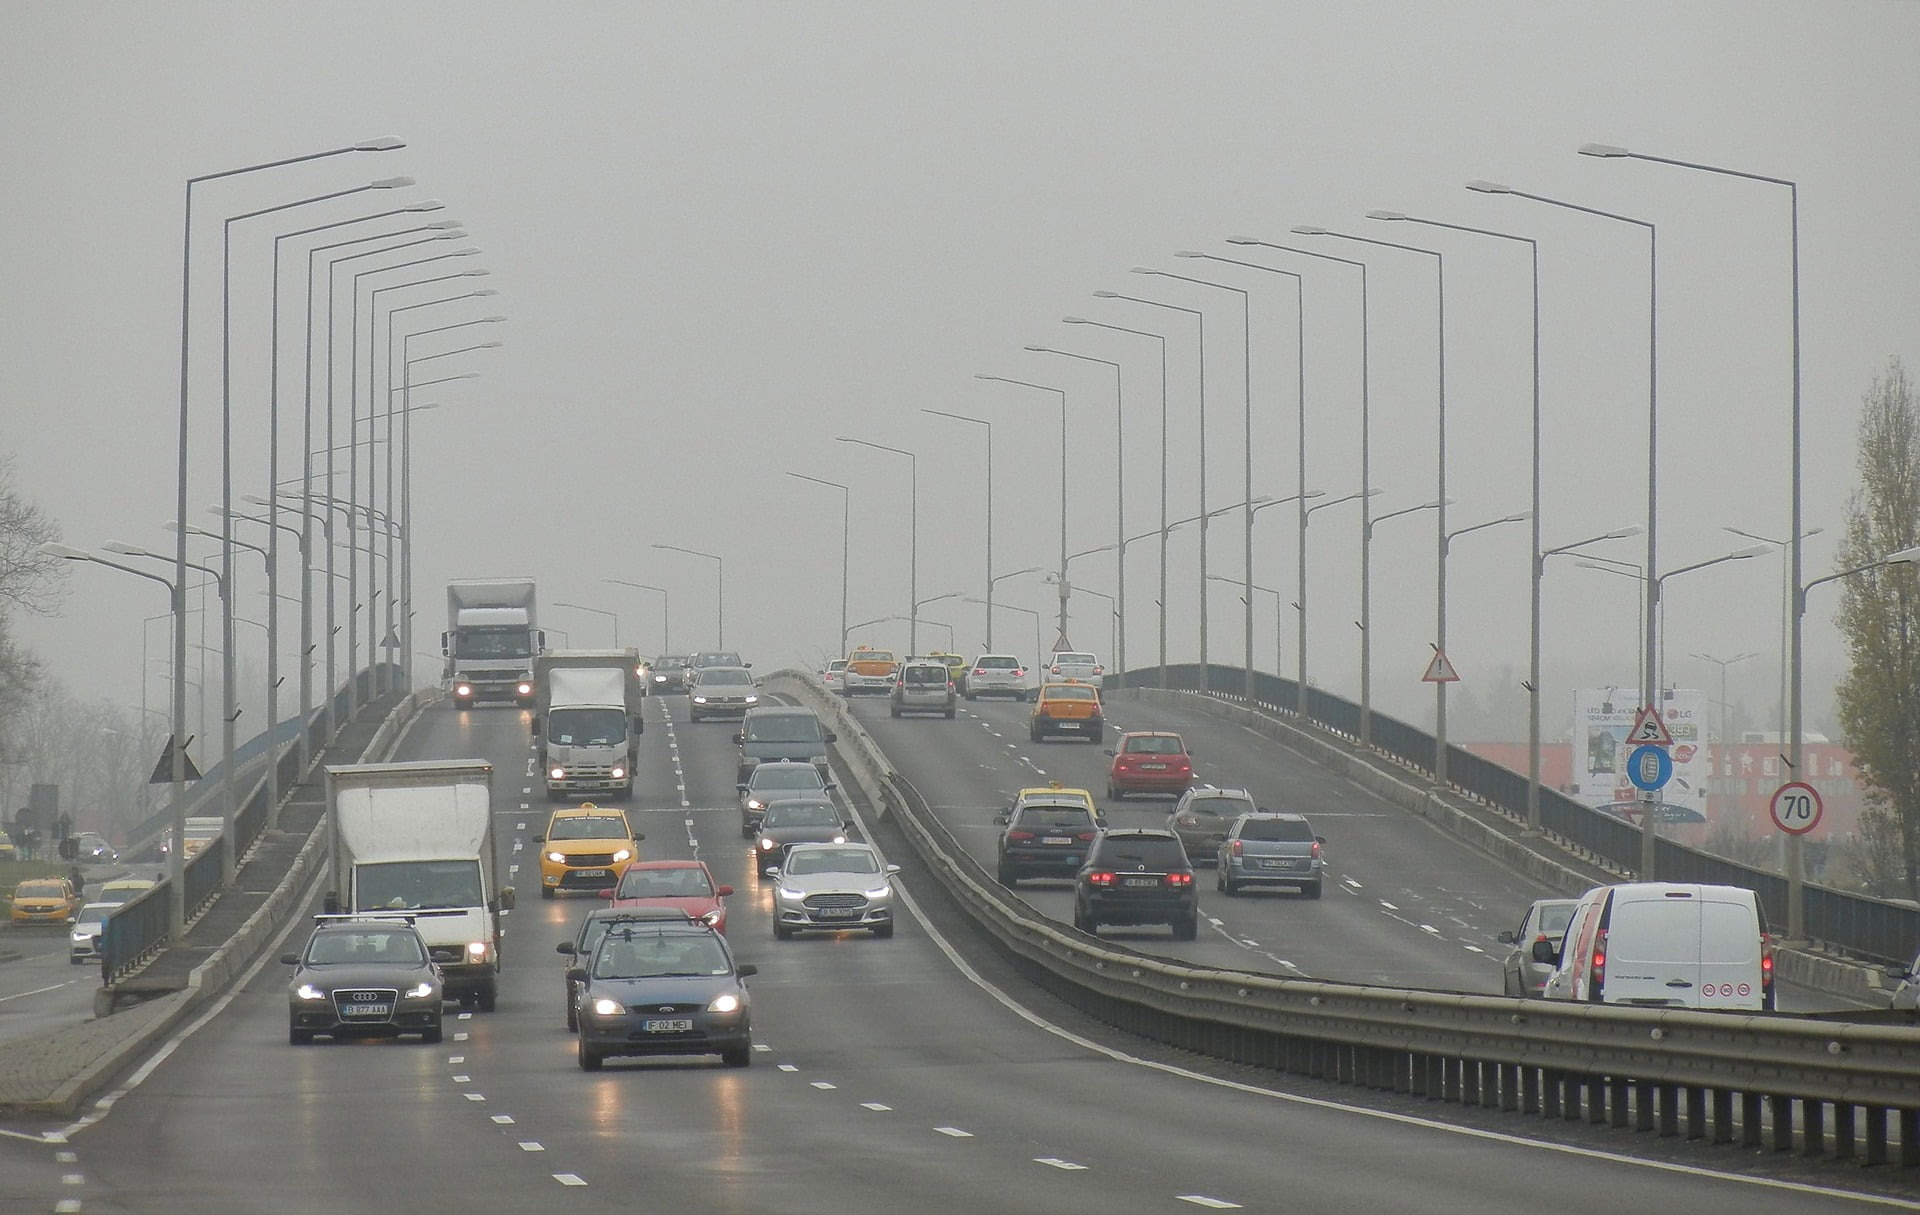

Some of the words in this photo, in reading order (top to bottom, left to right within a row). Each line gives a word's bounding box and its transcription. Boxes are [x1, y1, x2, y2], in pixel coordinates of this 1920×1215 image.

[1679, 710, 1692, 718] LG
[1784, 795, 1810, 819] 70
[659, 1021, 670, 1030] 02
